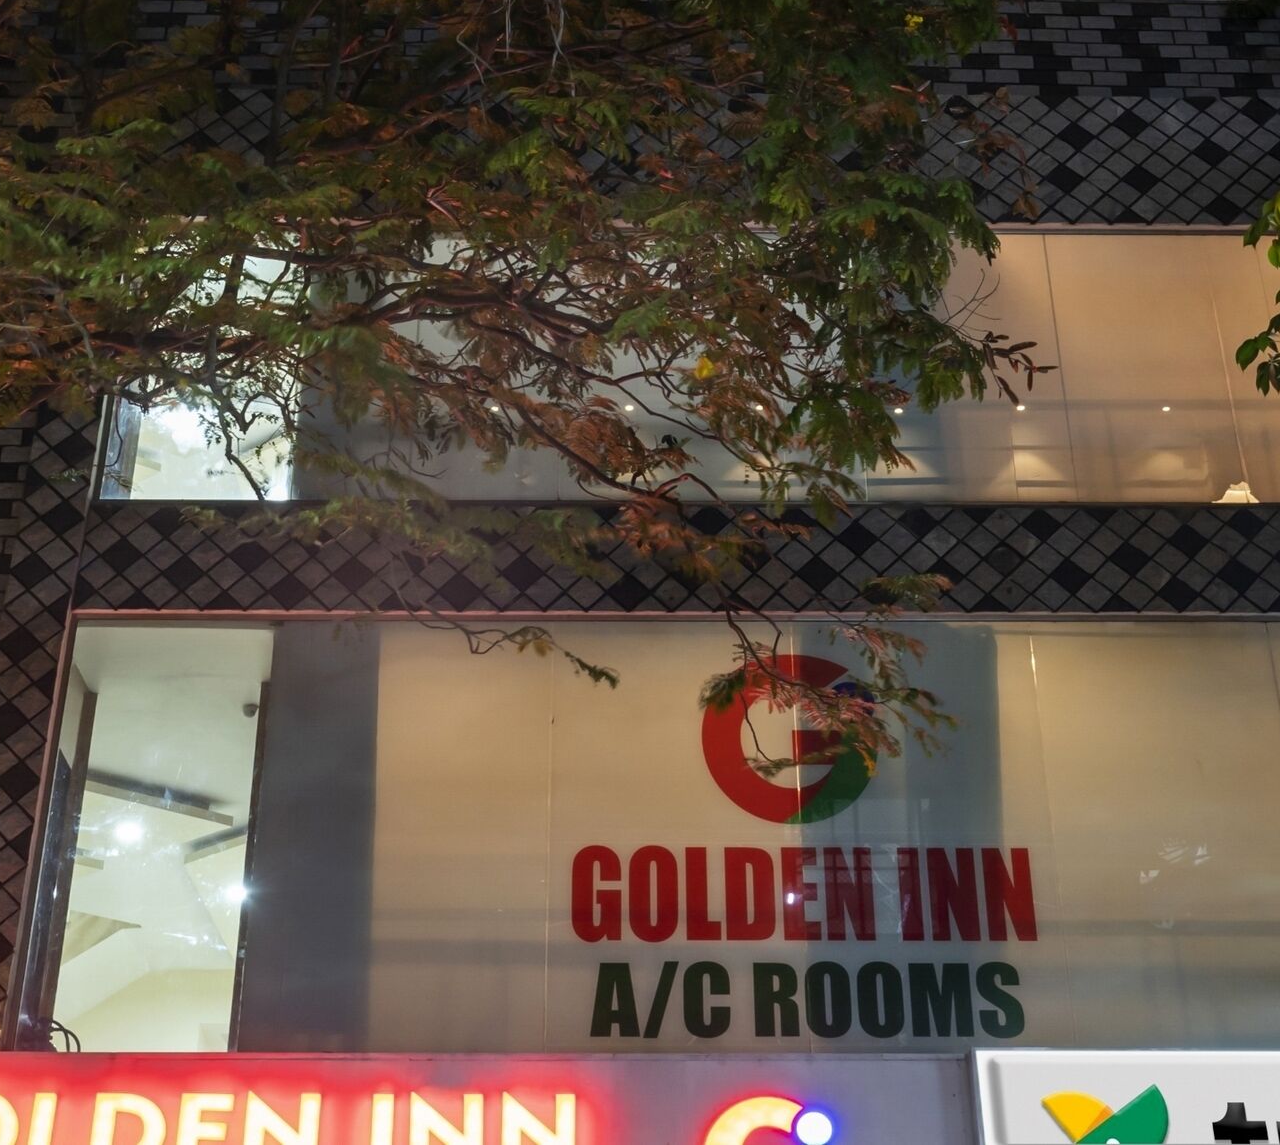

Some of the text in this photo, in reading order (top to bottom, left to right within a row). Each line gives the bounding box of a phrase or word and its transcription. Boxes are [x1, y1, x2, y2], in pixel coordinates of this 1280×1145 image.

[571, 845, 1038, 943] GOLDEN INN
[590, 961, 1026, 1039] A/C ROOMS
